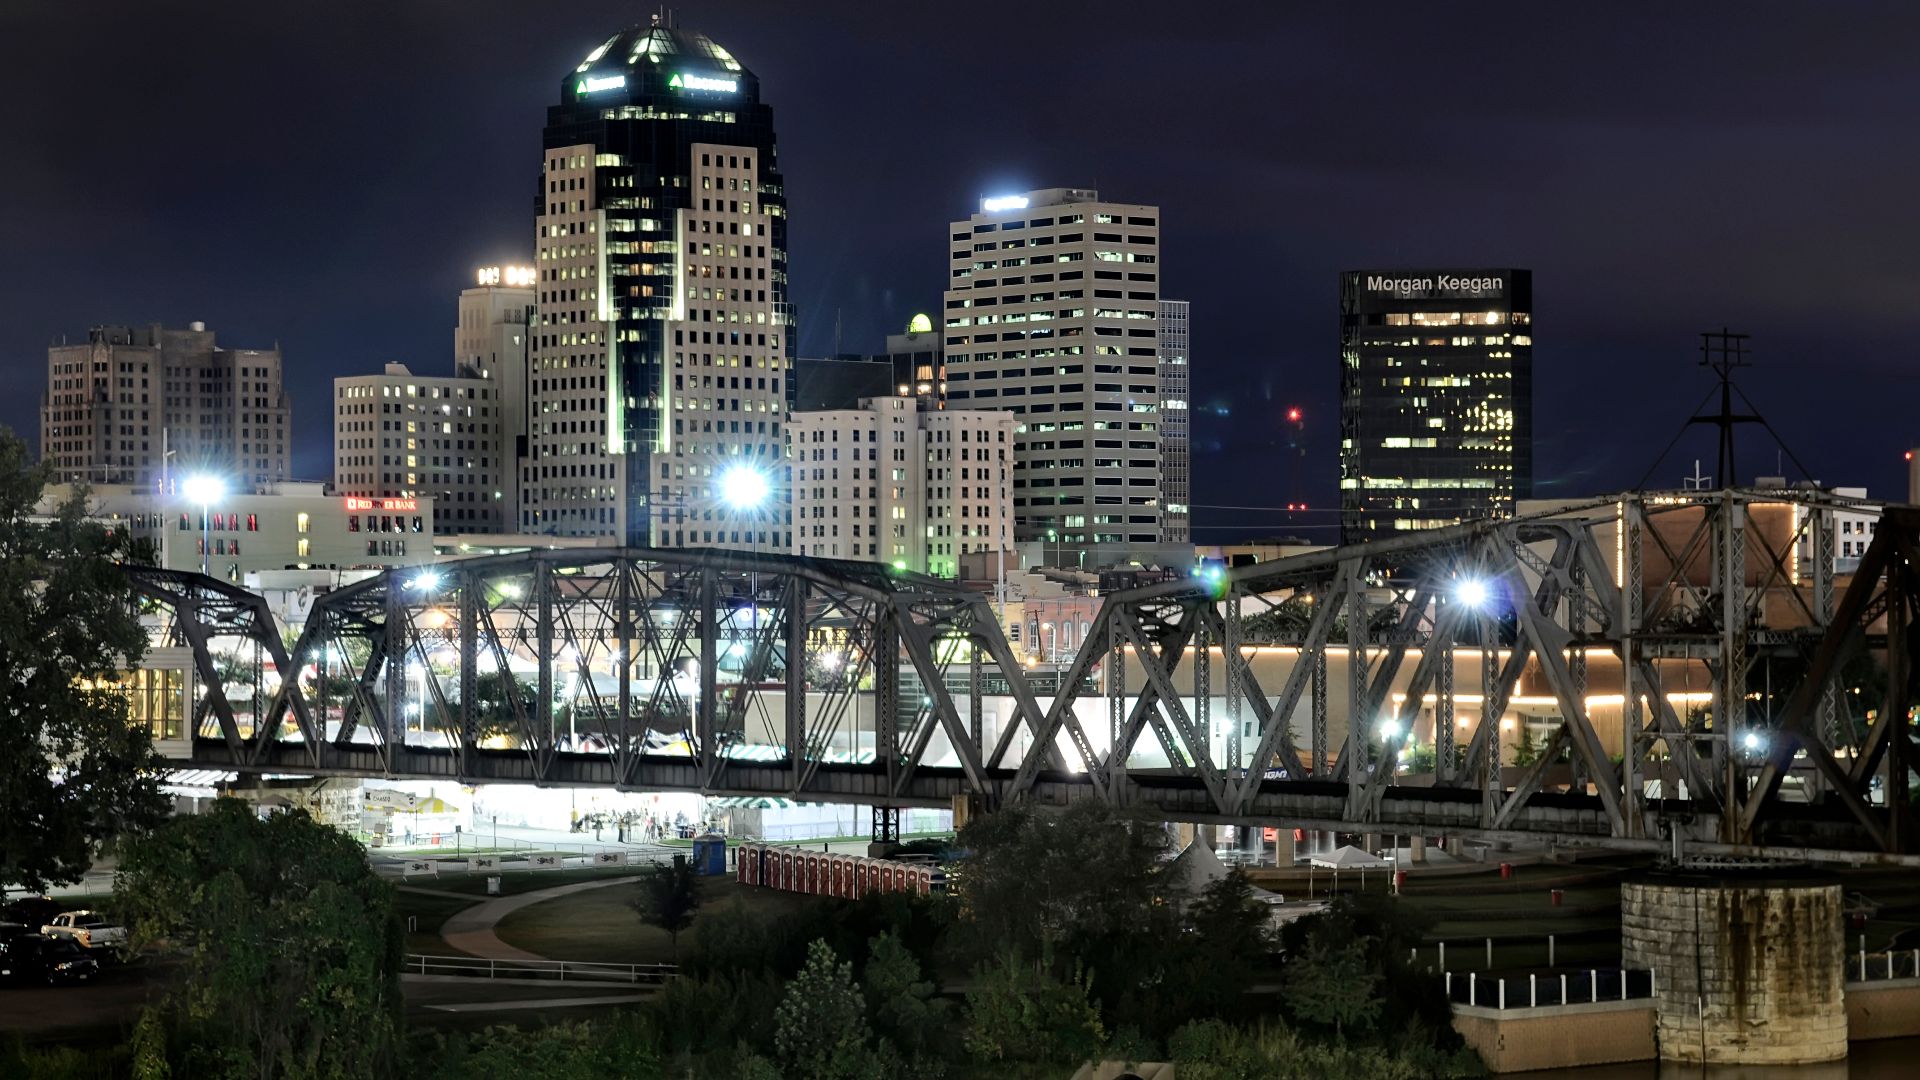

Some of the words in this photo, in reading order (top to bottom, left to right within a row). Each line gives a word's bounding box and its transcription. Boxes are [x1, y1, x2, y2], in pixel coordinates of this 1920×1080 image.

[1367, 276, 1433, 294] Morgan
[1438, 275, 1503, 293] Keegan
[1263, 770, 1288, 780] IGHT
